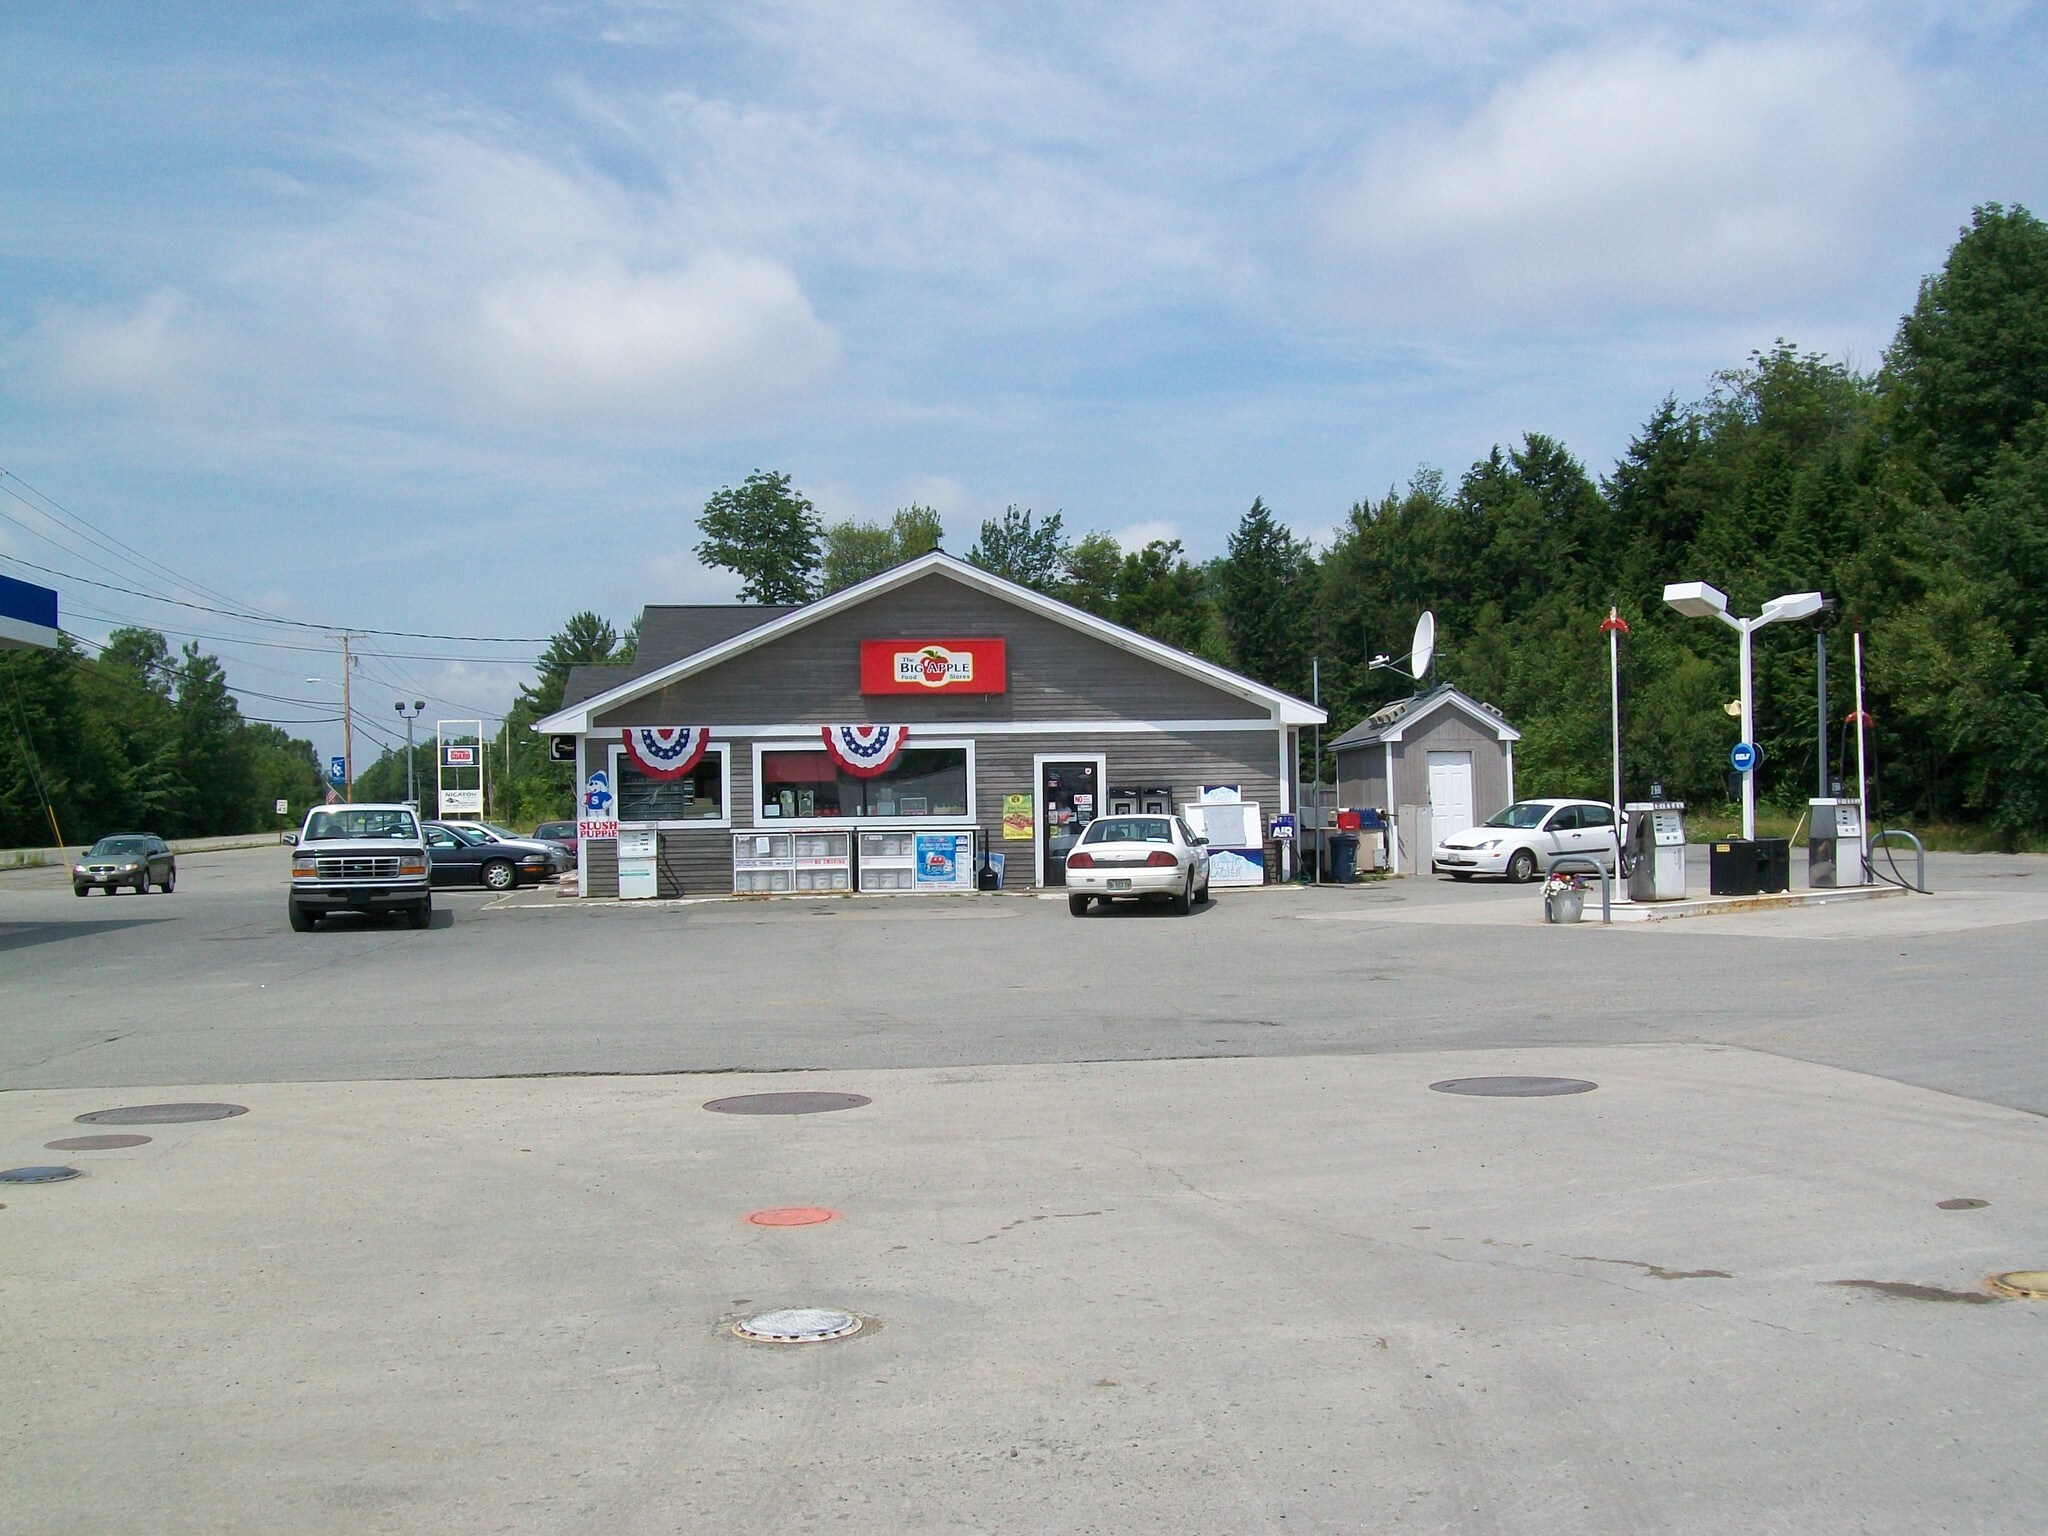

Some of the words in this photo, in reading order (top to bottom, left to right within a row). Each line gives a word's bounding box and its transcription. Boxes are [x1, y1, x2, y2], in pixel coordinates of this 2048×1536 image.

[900, 663, 923, 673] BIG
[927, 662, 970, 673] APPLE
[579, 821, 618, 830] SLUSH
[1272, 826, 1293, 838] AIR
[1210, 858, 1243, 870] RCTIC
[1209, 869, 1243, 878] LACIER
